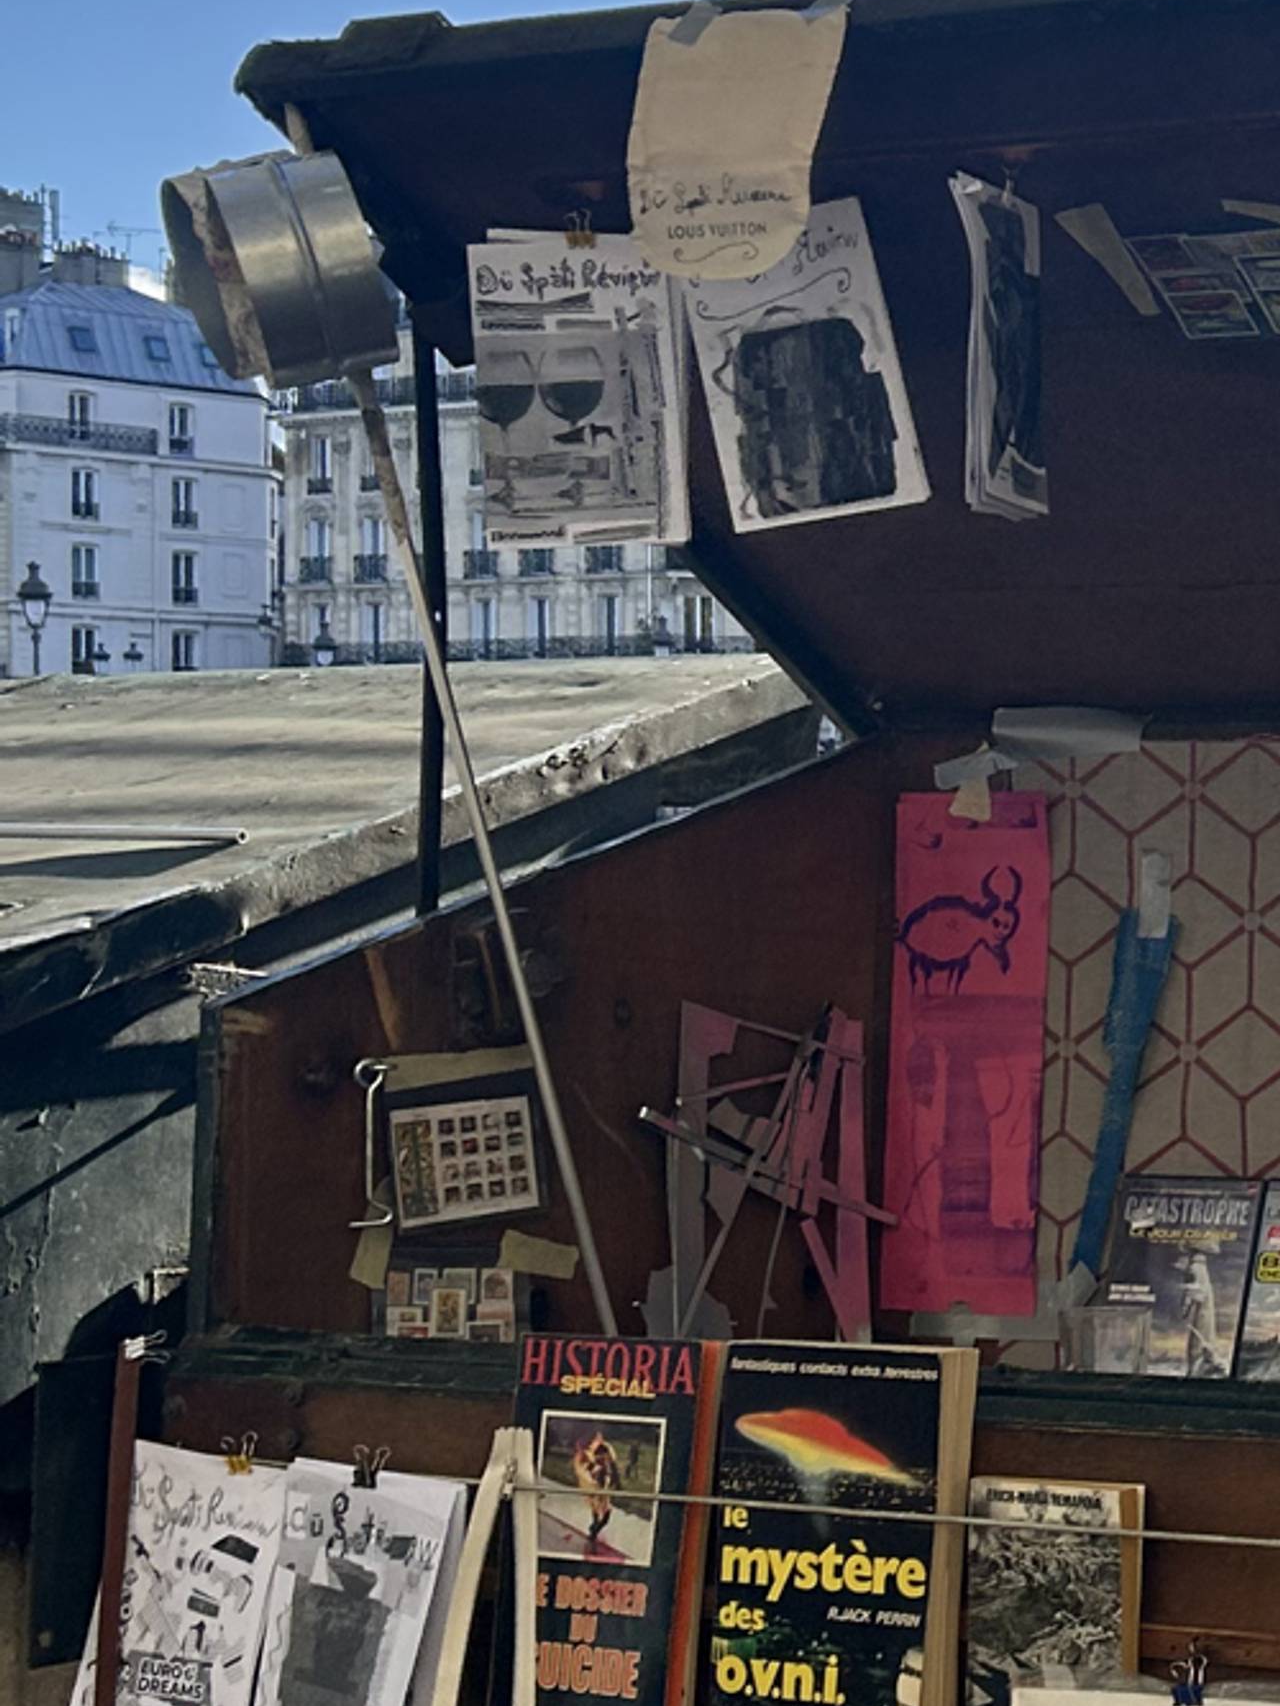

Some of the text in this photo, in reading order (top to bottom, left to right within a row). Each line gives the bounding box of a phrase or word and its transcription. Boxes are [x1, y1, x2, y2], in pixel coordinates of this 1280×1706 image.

[668, 220, 767, 240] LOUIS VUITTON
[521, 1337, 696, 1395] HISTORIA
[560, 1372, 657, 1400] SPÉCIAL
[723, 1505, 749, 1529] le
[720, 1539, 926, 1602] mystère
[554, 1574, 649, 1618] DOSSIER
[719, 1600, 765, 1631] des
[138, 1678, 203, 1699] DREAMS
[537, 1641, 641, 1699] UICIDE
[716, 1654, 846, 1706] o.v.n.i.
